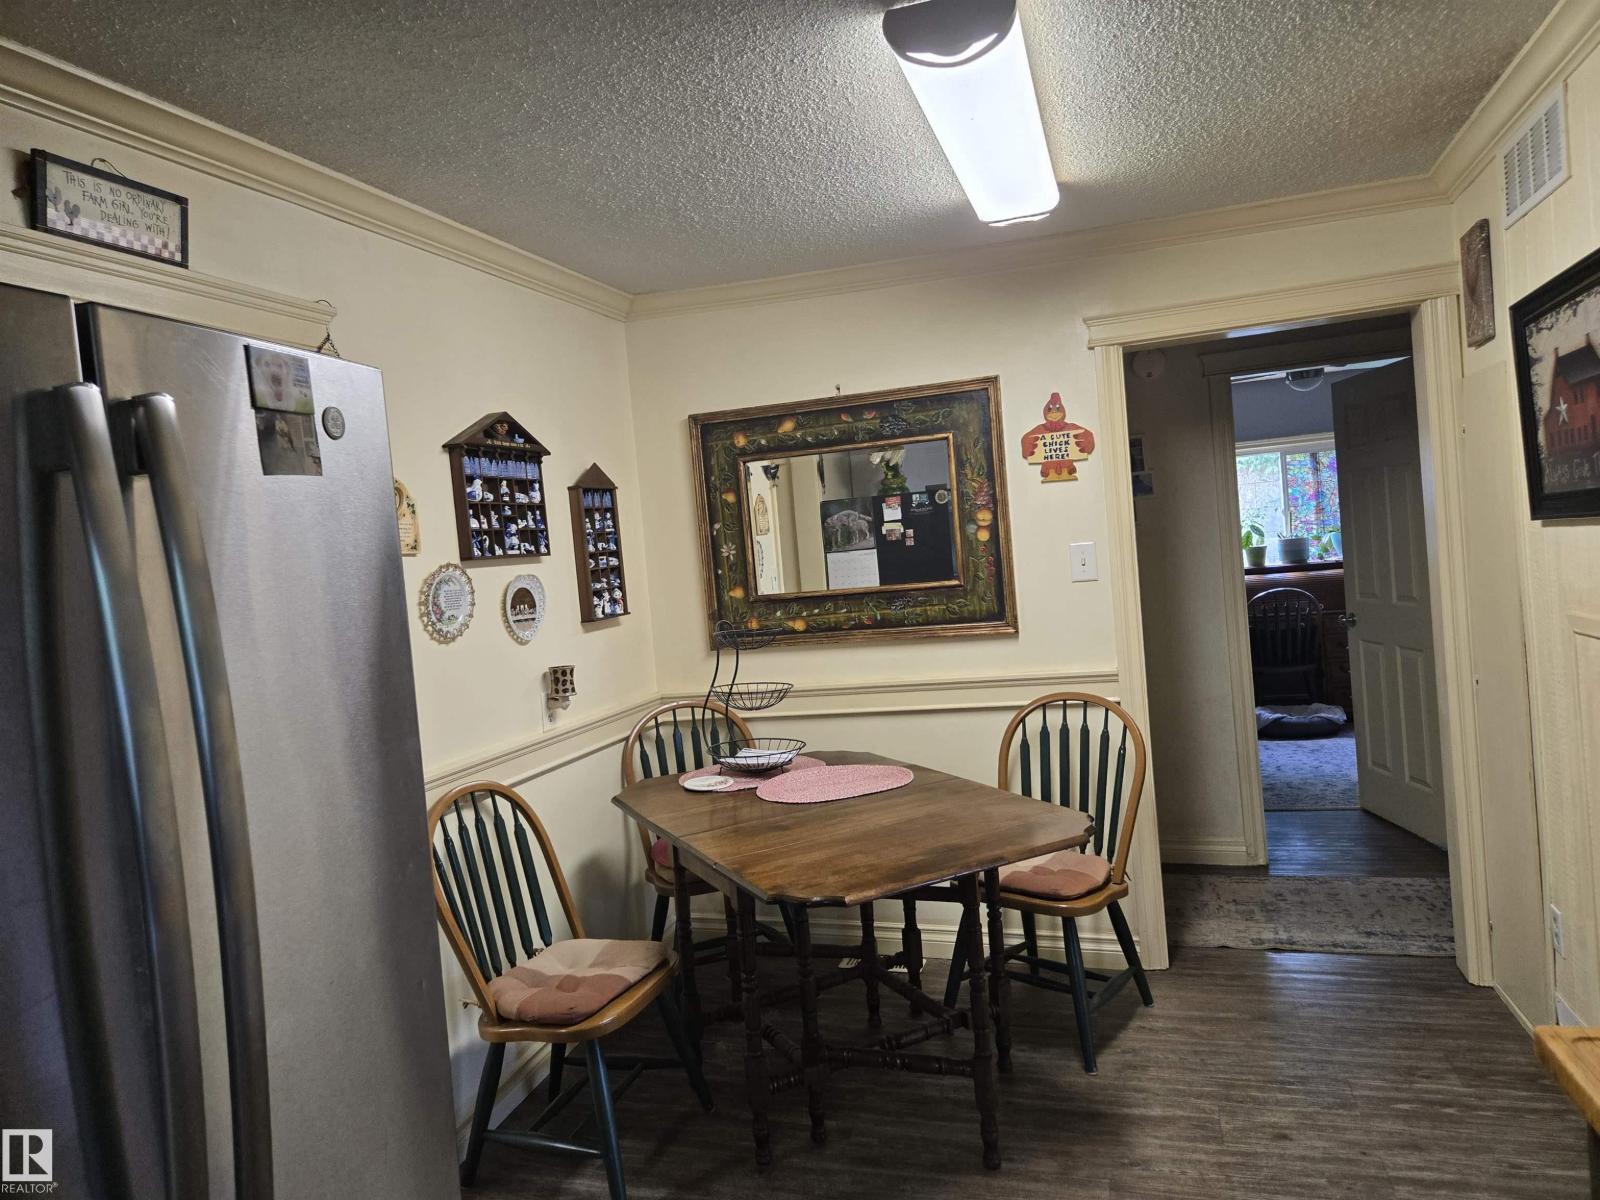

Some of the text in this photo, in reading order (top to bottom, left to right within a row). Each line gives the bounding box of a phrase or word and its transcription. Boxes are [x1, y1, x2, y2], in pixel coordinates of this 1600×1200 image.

[63, 170, 165, 215] THIS IS NO ORDINARY
[82, 190, 107, 208] FARM
[111, 200, 133, 215] GIRL
[100, 210, 139, 228] DEALING
[1043, 440, 1070, 448] CHICK
